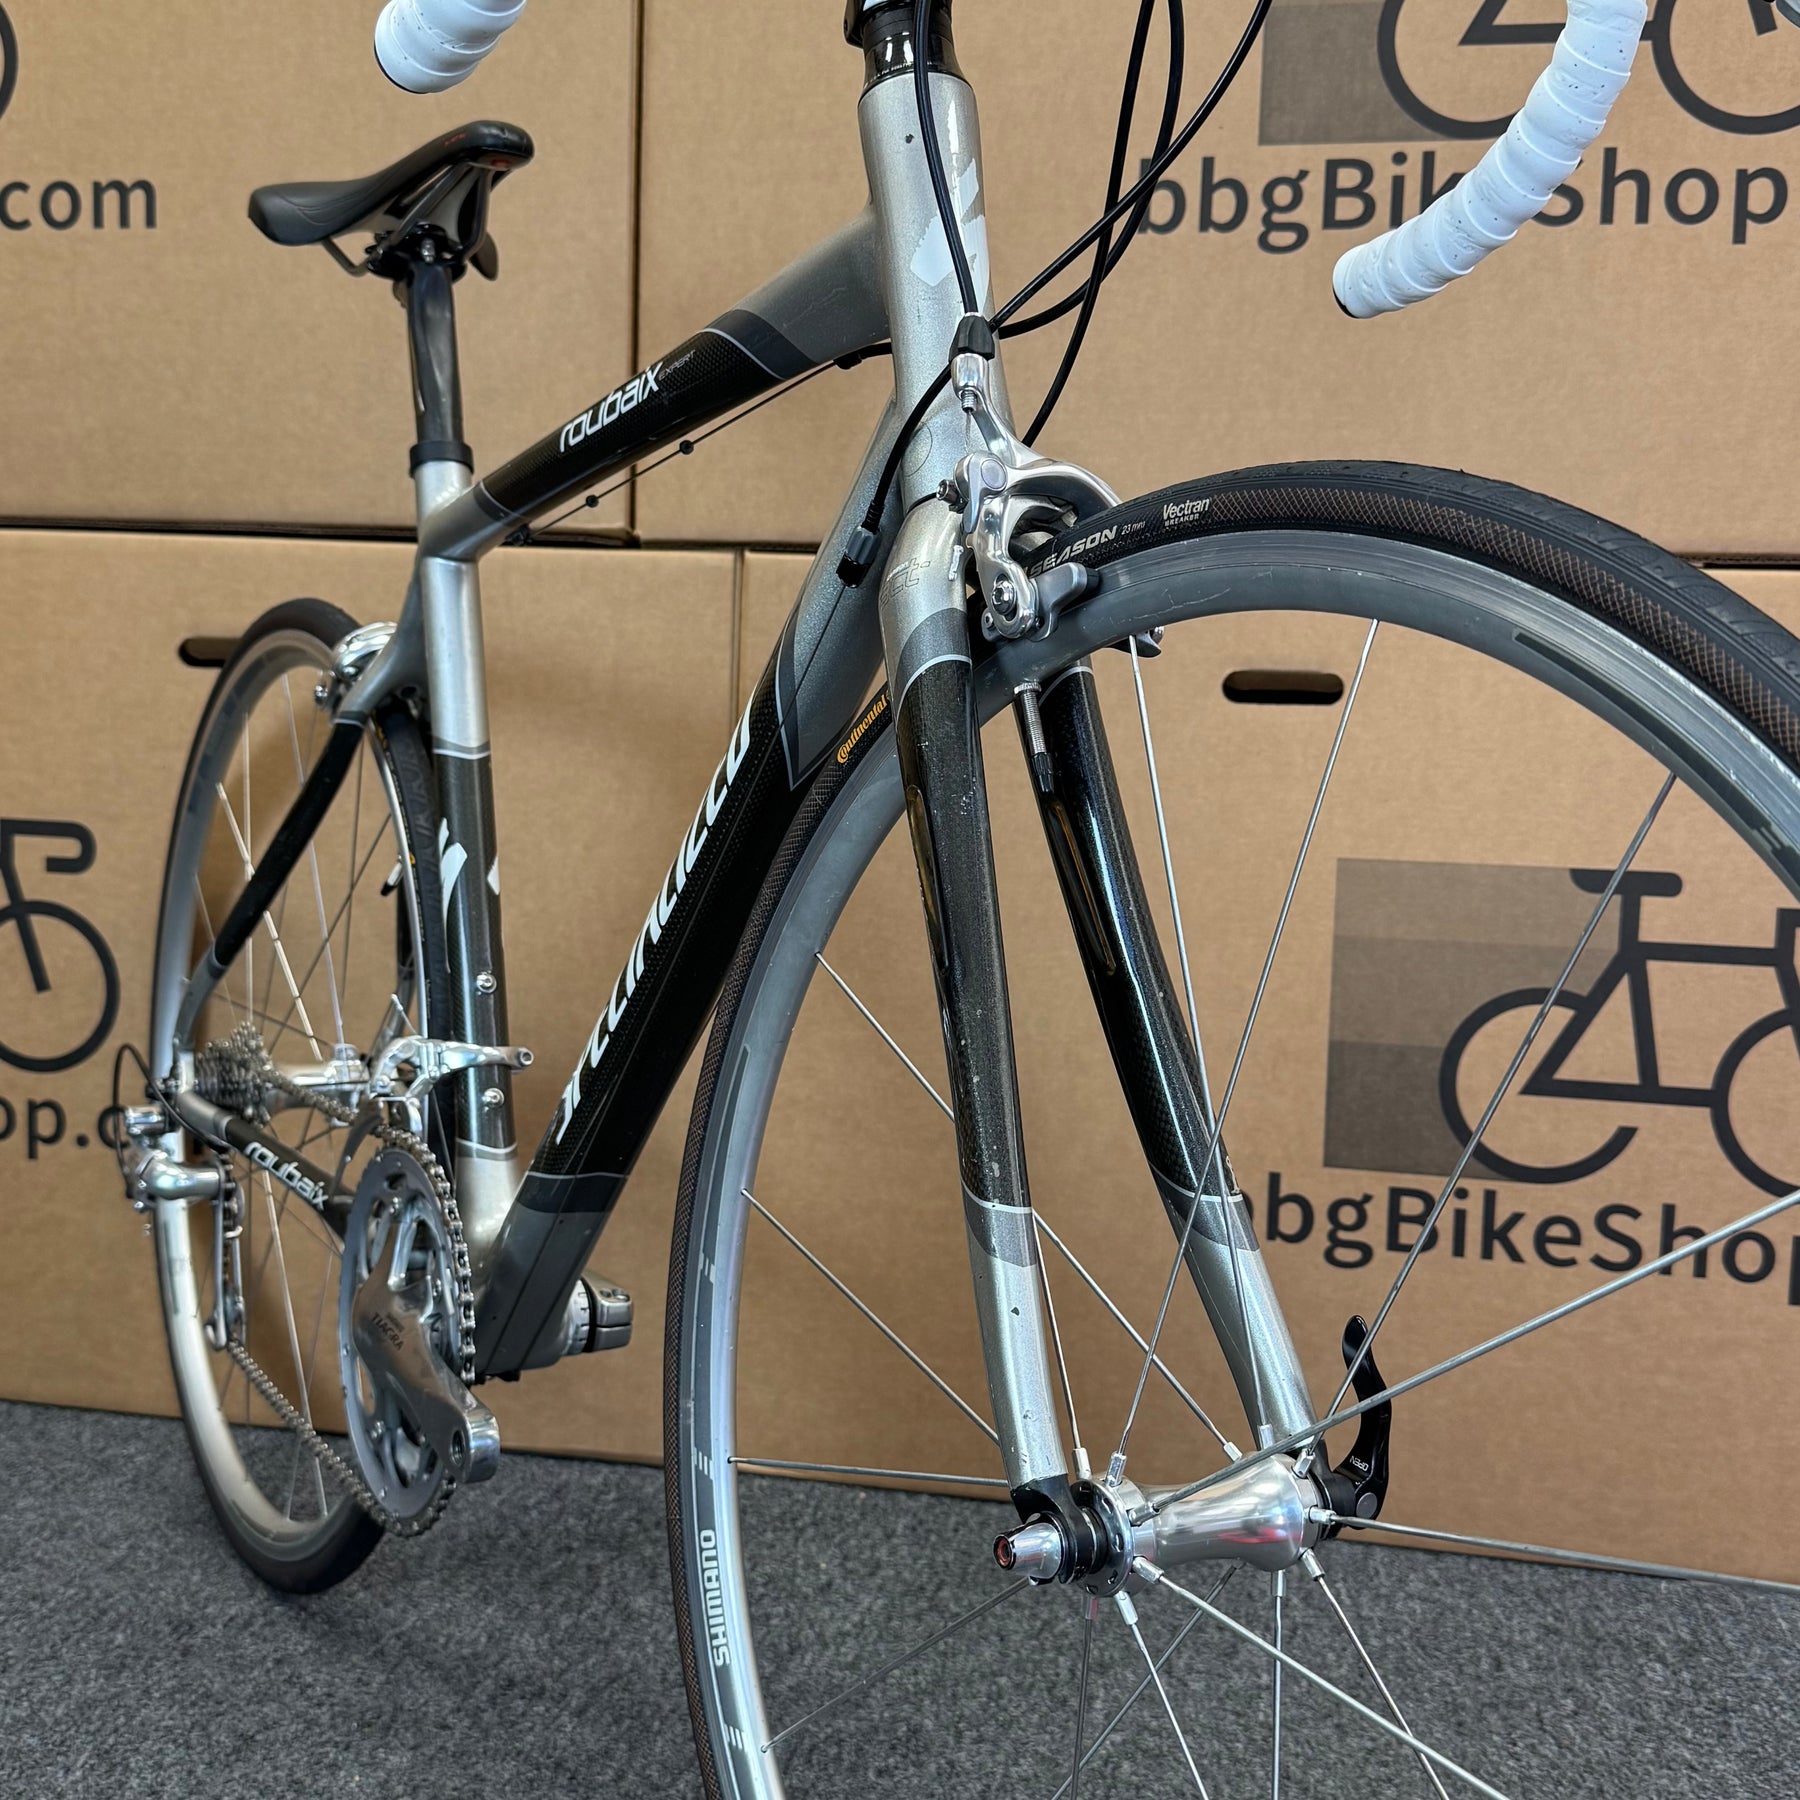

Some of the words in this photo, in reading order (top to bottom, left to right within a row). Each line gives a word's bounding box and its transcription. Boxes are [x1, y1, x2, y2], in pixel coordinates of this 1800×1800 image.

[0, 179, 157, 231] com
[560, 361, 663, 453] roubaix
[658, 350, 696, 381] EXPERT
[1163, 498, 1210, 520] Vectran
[1165, 513, 1200, 527] BREAKER
[836, 694, 888, 764] Continental
[244, 1141, 329, 1211] roubaix
[1350, 1455, 1369, 1472] OPEN
[700, 1529, 731, 1667] SHIMANO
